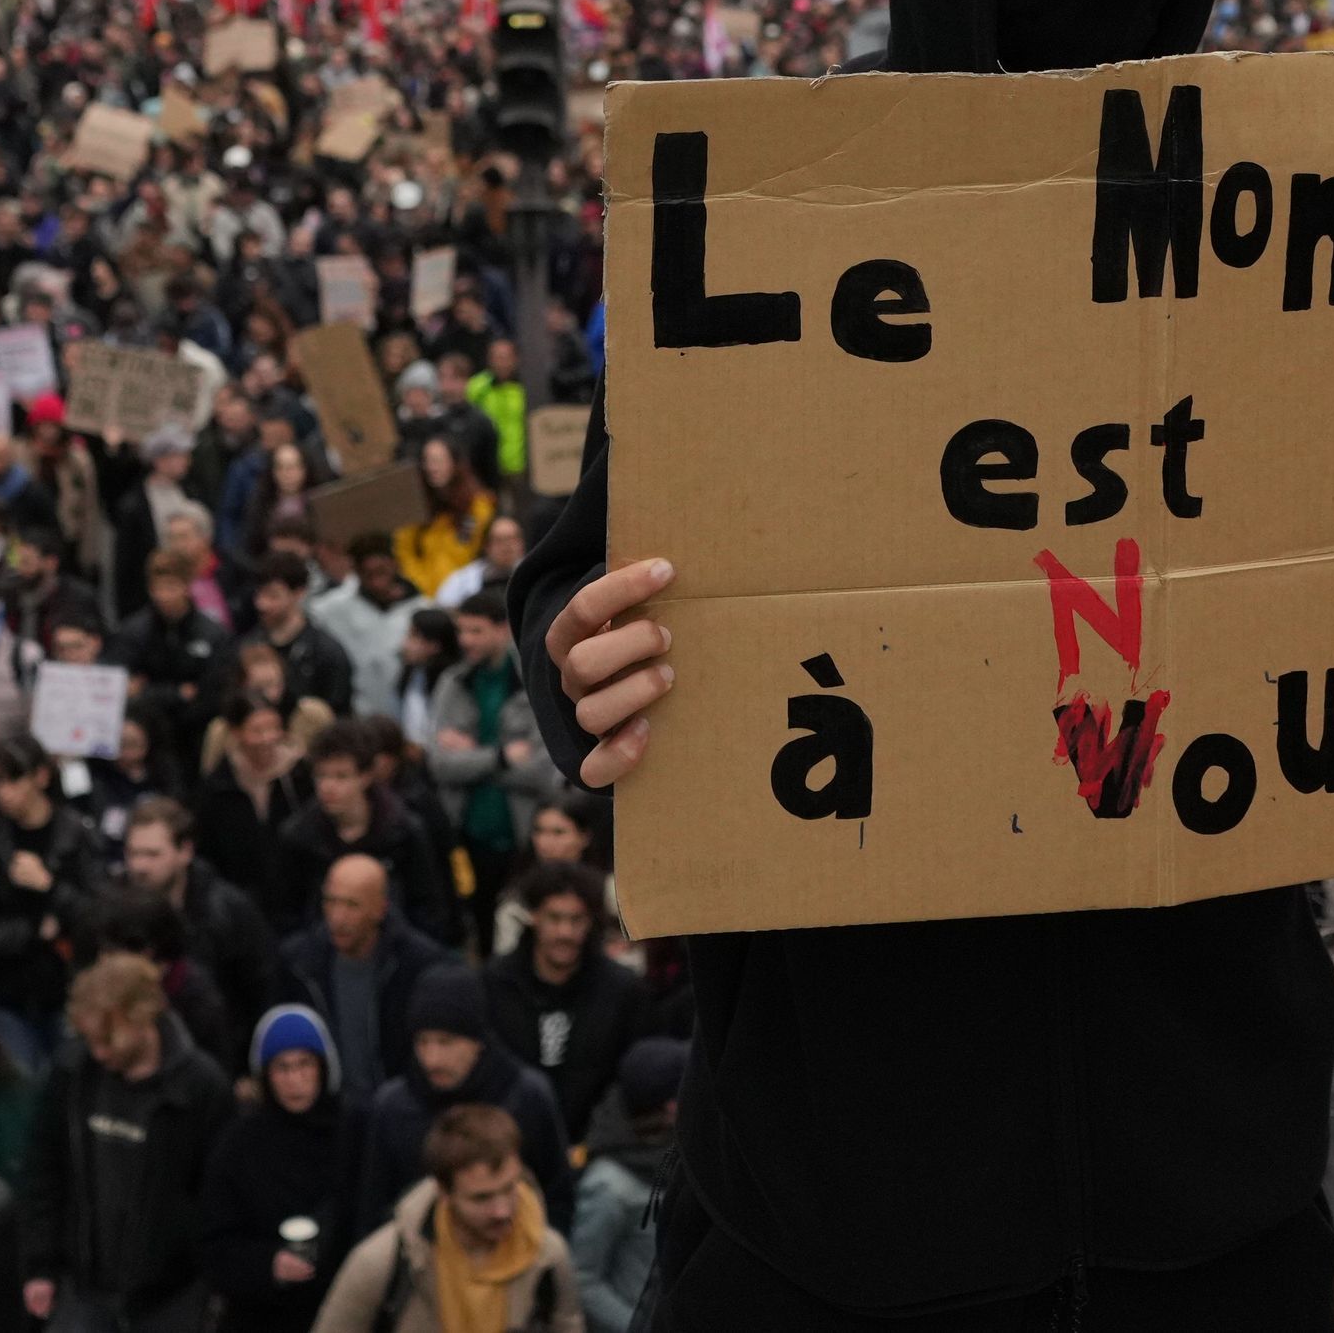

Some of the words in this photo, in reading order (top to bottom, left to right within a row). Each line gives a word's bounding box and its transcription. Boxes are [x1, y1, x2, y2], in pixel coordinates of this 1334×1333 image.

[651, 131, 933, 363] Le
[939, 394, 1205, 532] est
[771, 652, 874, 821] à
